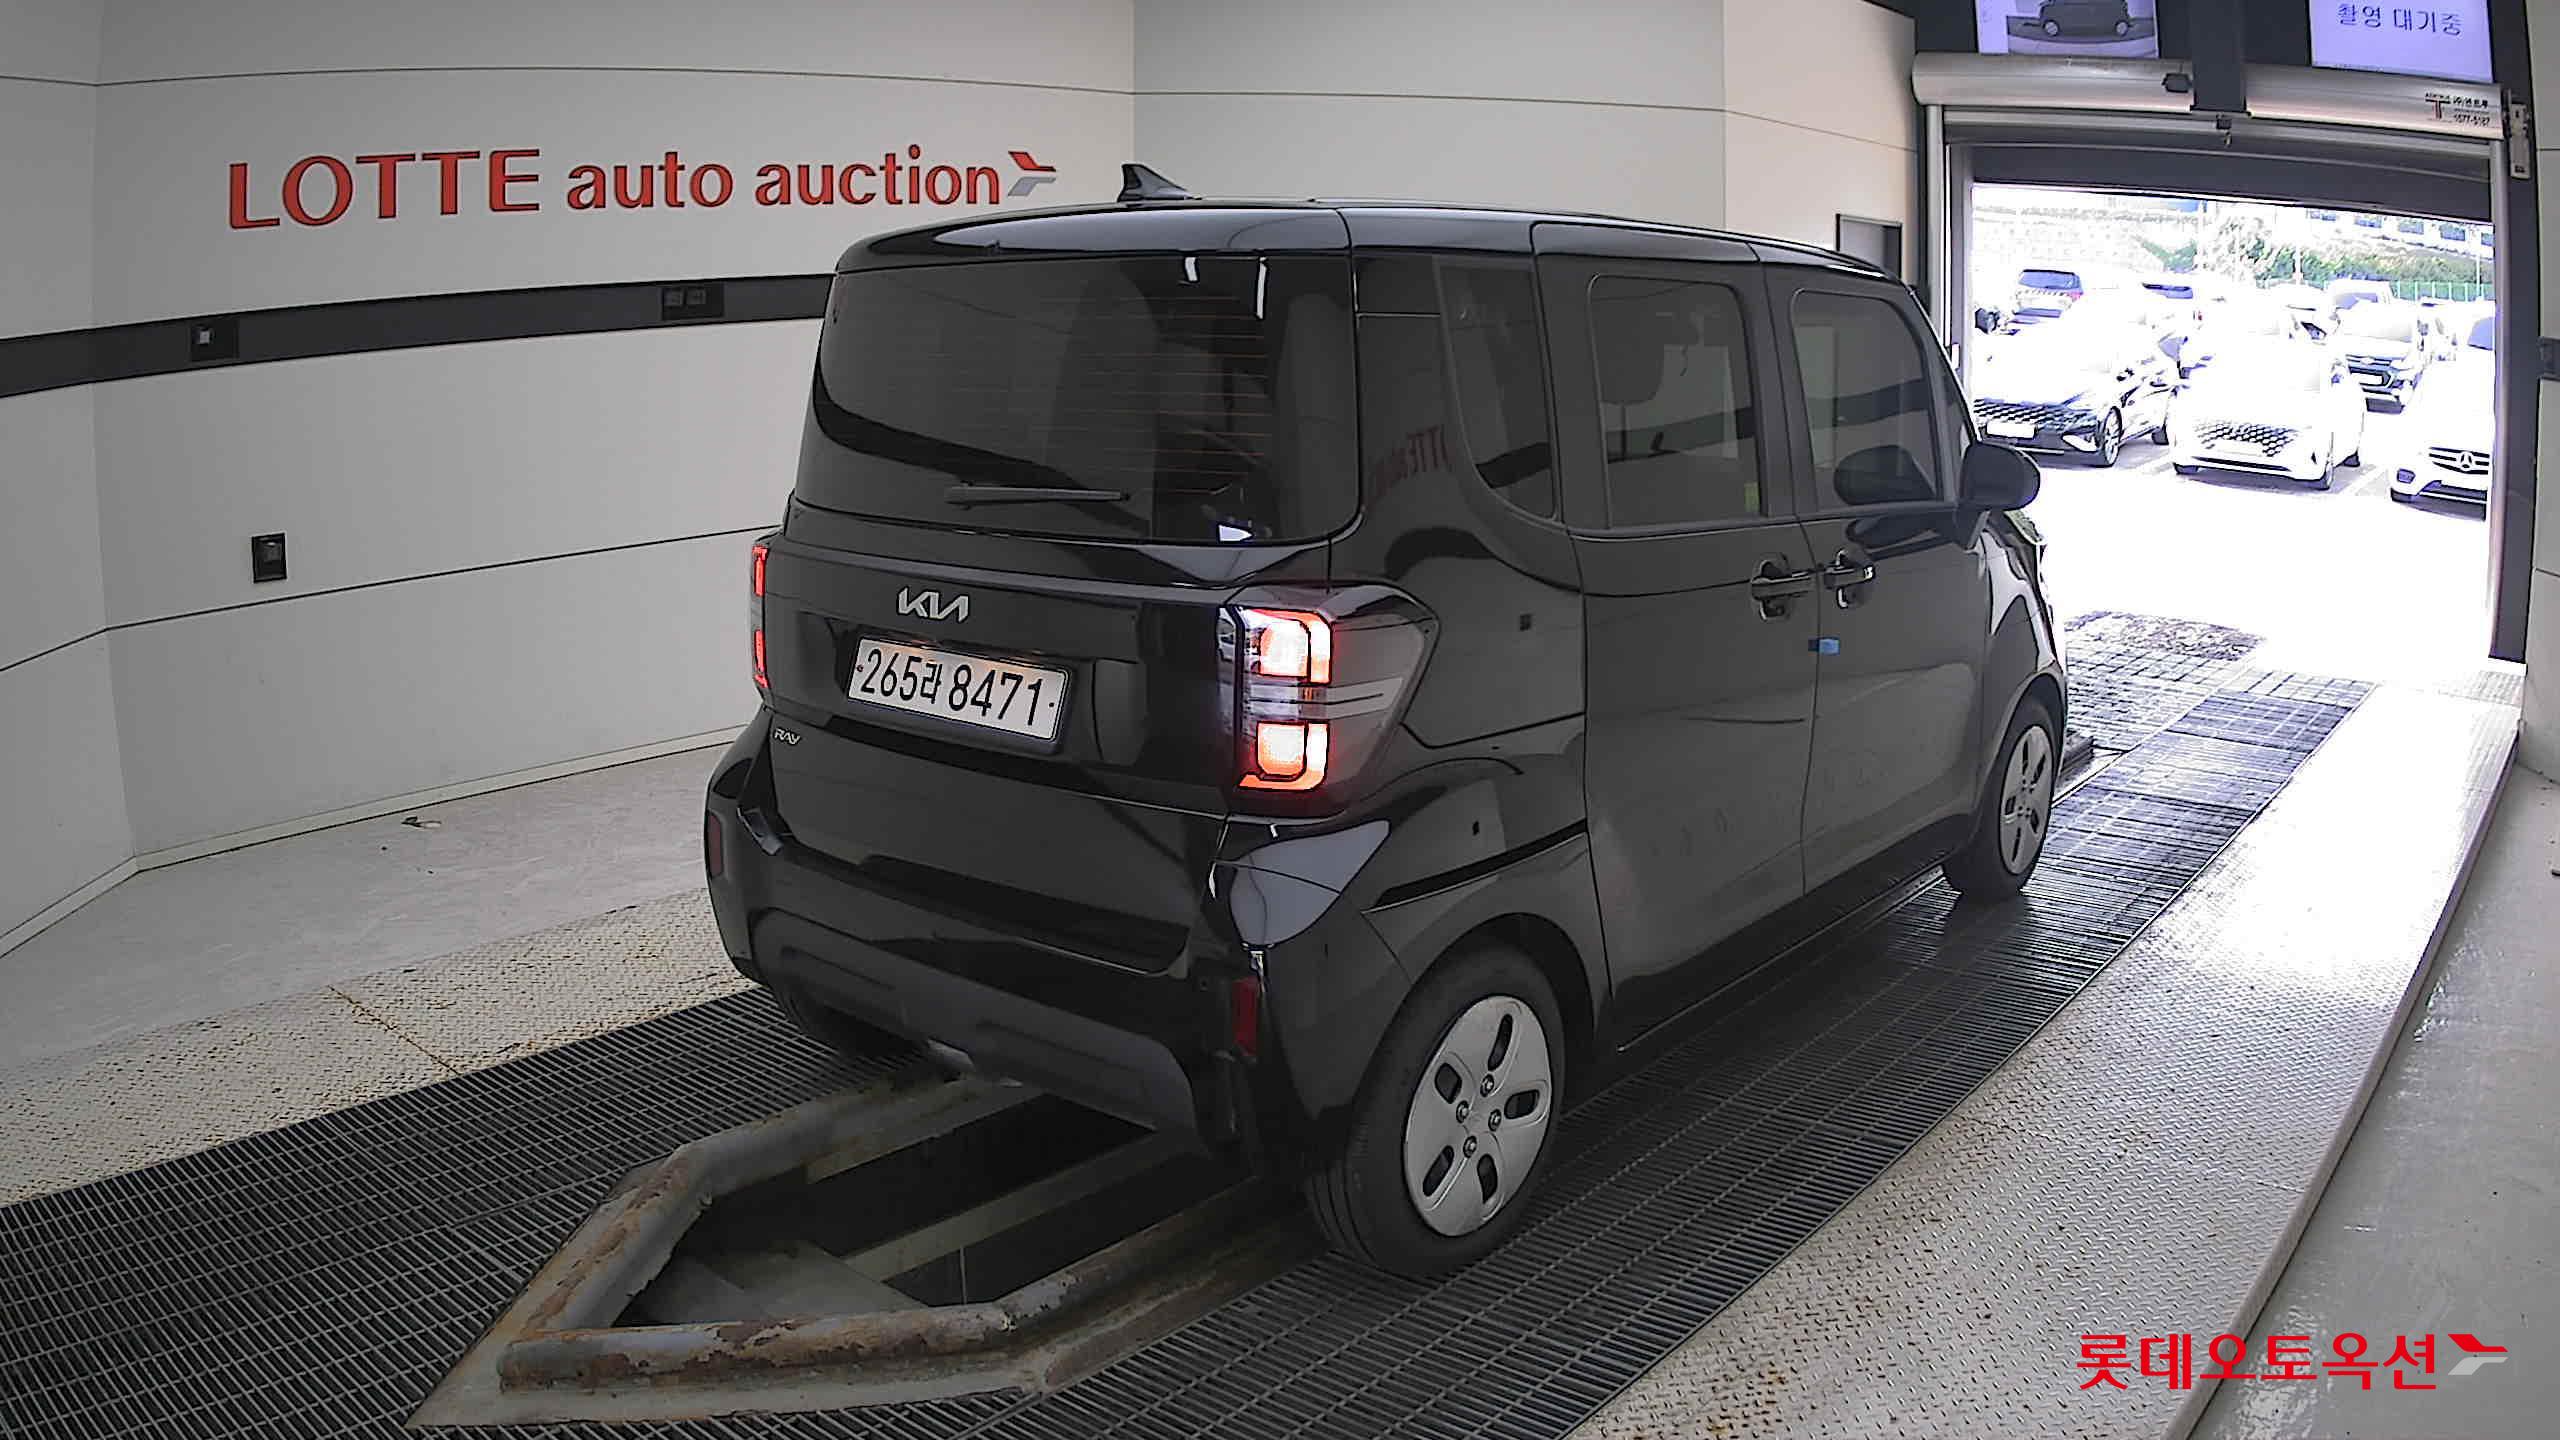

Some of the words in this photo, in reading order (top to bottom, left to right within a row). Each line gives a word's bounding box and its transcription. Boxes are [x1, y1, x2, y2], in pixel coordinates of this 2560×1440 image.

[2336, 2, 2383, 30] 촬영
[2392, 8, 2462, 36] 대기중
[228, 148, 541, 230] LOTTE
[567, 150, 733, 209] auto
[754, 144, 1000, 206] auction
[861, 649, 942, 704] 265라
[948, 663, 1043, 726] 8471
[774, 727, 801, 745] RAY
